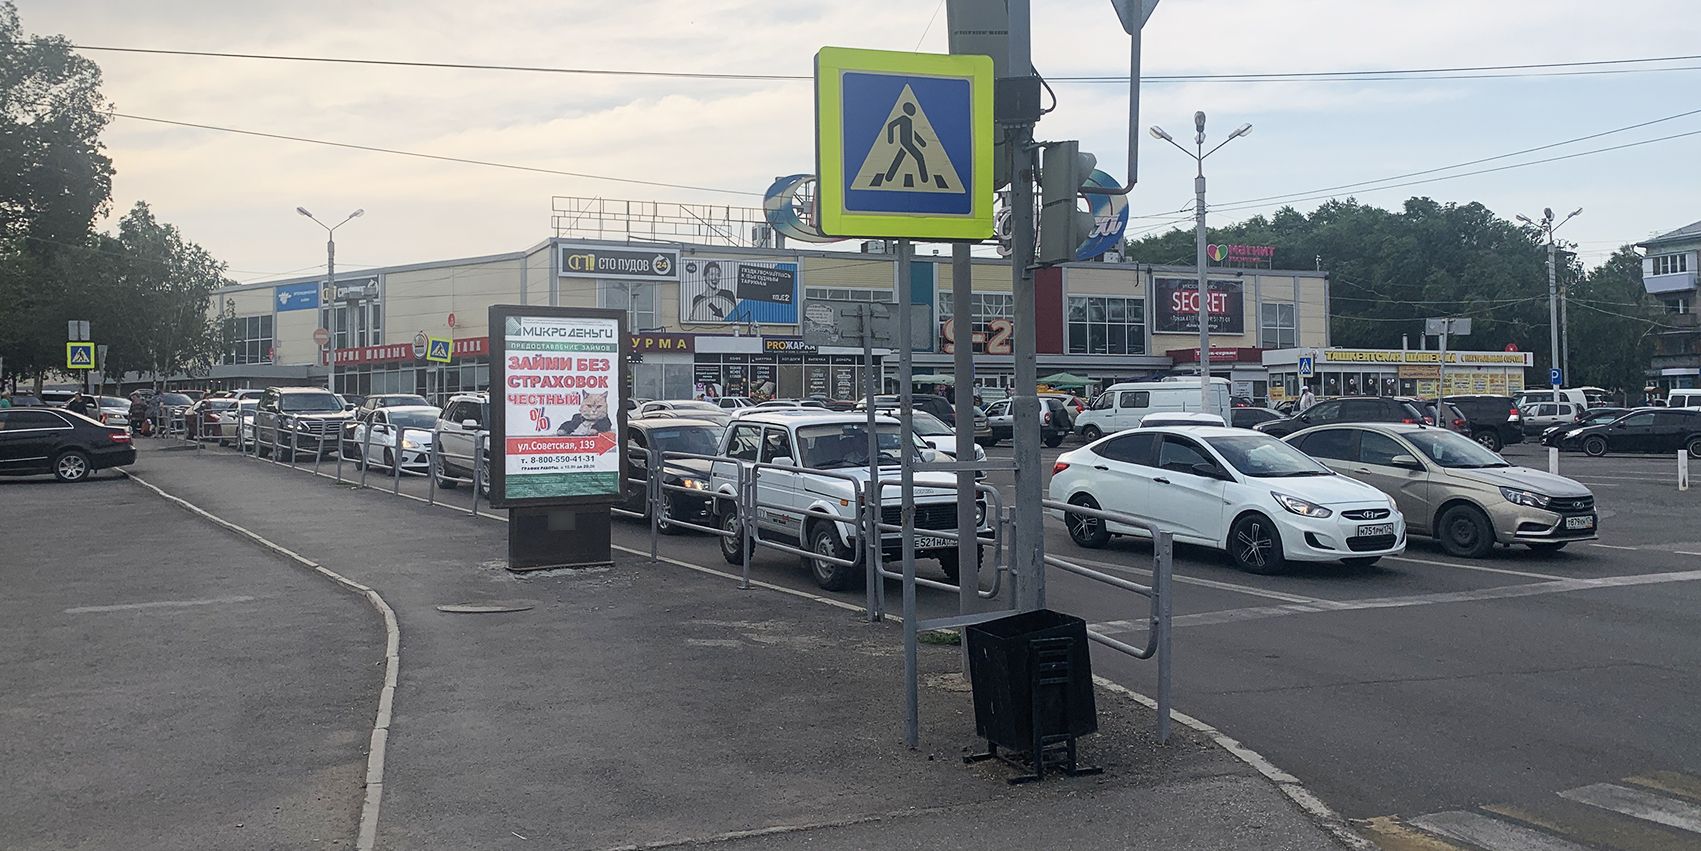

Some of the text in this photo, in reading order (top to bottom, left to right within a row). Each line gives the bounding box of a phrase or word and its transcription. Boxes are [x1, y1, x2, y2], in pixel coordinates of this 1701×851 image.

[598, 257, 649, 272] СТО ПУДОВ
[656, 261, 667, 269] 24
[511, 342, 578, 350] ПРЕДОСТАВЛЕНИЕ
[508, 354, 610, 372] ЗАЙМИ БЕЗ
[1324, 351, 1403, 363] ТАШКЕНТСКАЯ
[507, 375, 609, 388] СТРАХОВОК
[508, 392, 581, 405] ЧЕСТНЫЙ
[580, 440, 595, 449] 139
[530, 455, 595, 464] 8-800-550-41-31
